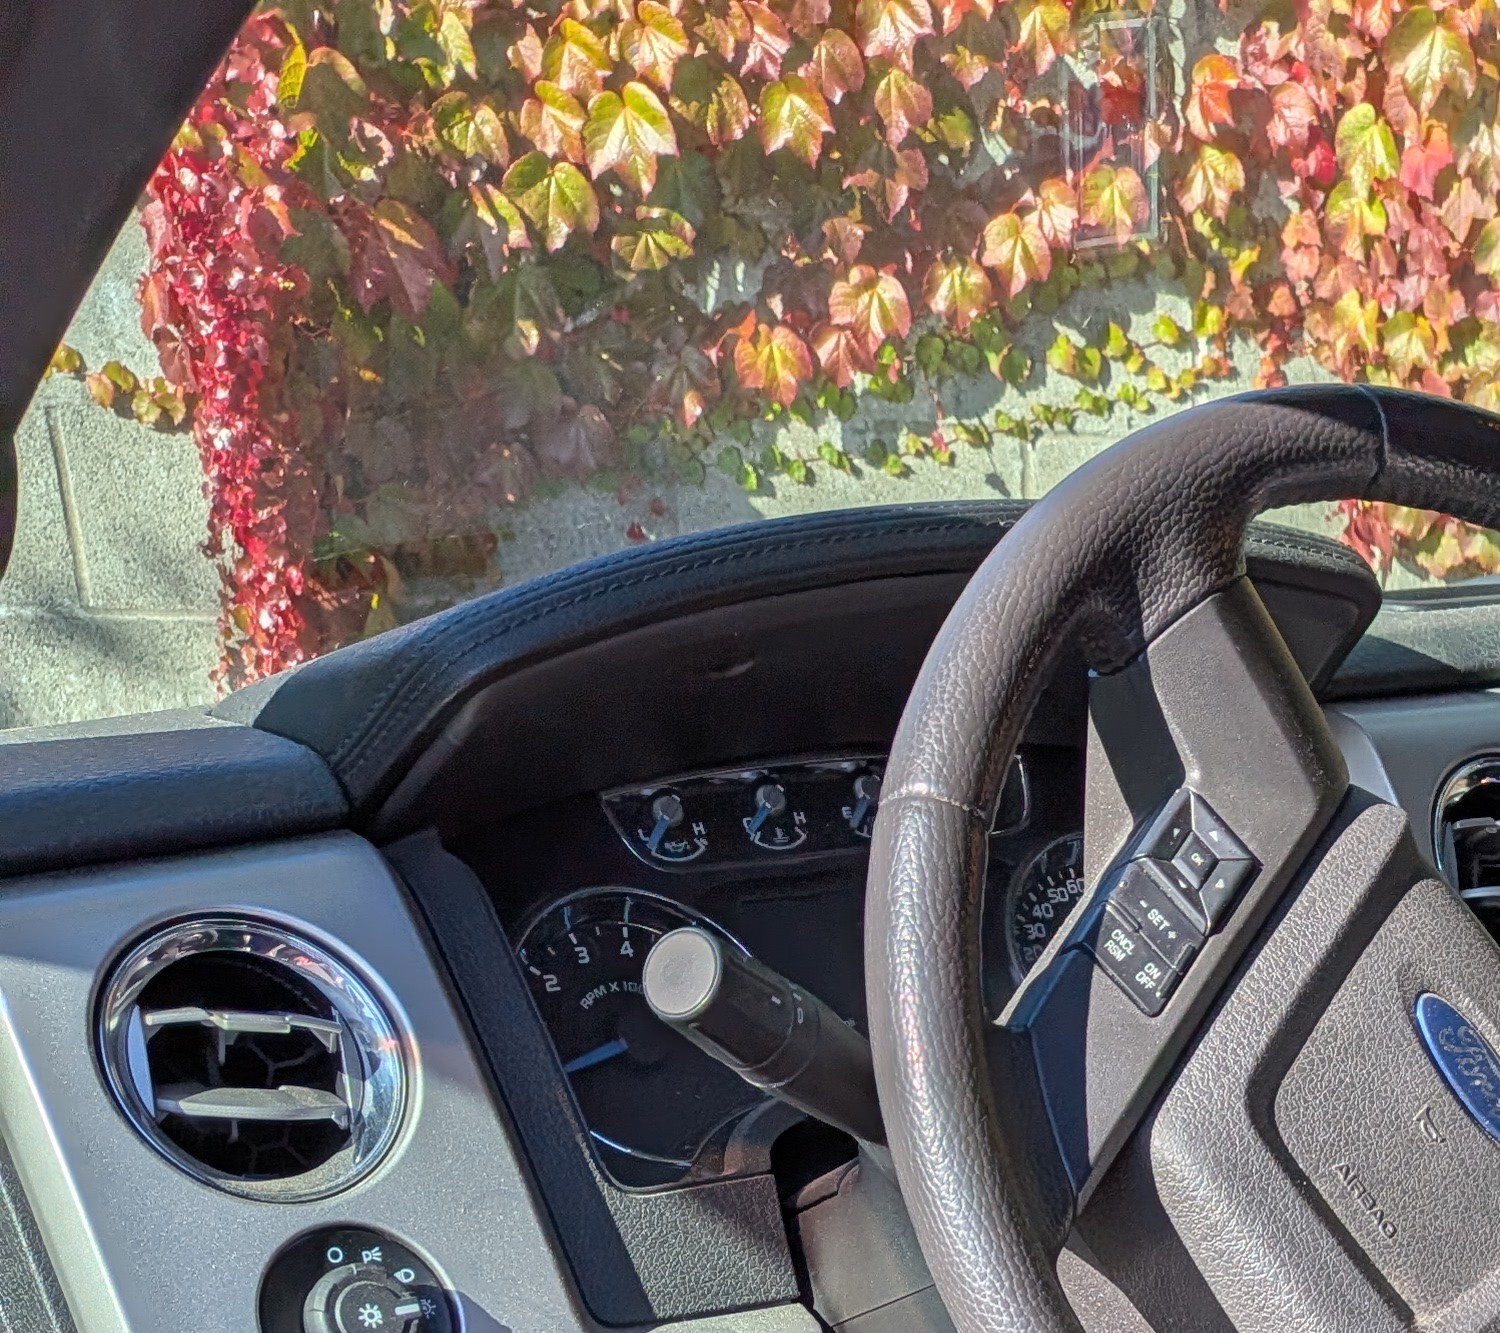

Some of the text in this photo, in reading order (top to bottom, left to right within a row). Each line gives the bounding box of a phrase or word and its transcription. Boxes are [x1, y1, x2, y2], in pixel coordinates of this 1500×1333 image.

[792, 811, 806, 825] H
[841, 805, 852, 819] E
[692, 821, 706, 836] H
[1190, 852, 1205, 867] OK
[1047, 887, 1069, 904] 50
[1032, 902, 1054, 919] 40
[1146, 908, 1171, 931] SET
[1023, 923, 1046, 940] 30
[619, 940, 634, 958] 4
[1103, 939, 1127, 962] RSM
[1110, 928, 1136, 955] CNCL
[574, 946, 590, 964] 3
[1143, 962, 1161, 980] ON
[542, 973, 561, 992] 2
[1134, 971, 1156, 990] OFF
[579, 984, 608, 1010] RPM
[608, 980, 620, 993] X
[1331, 1162, 1398, 1240] AIRBAG
